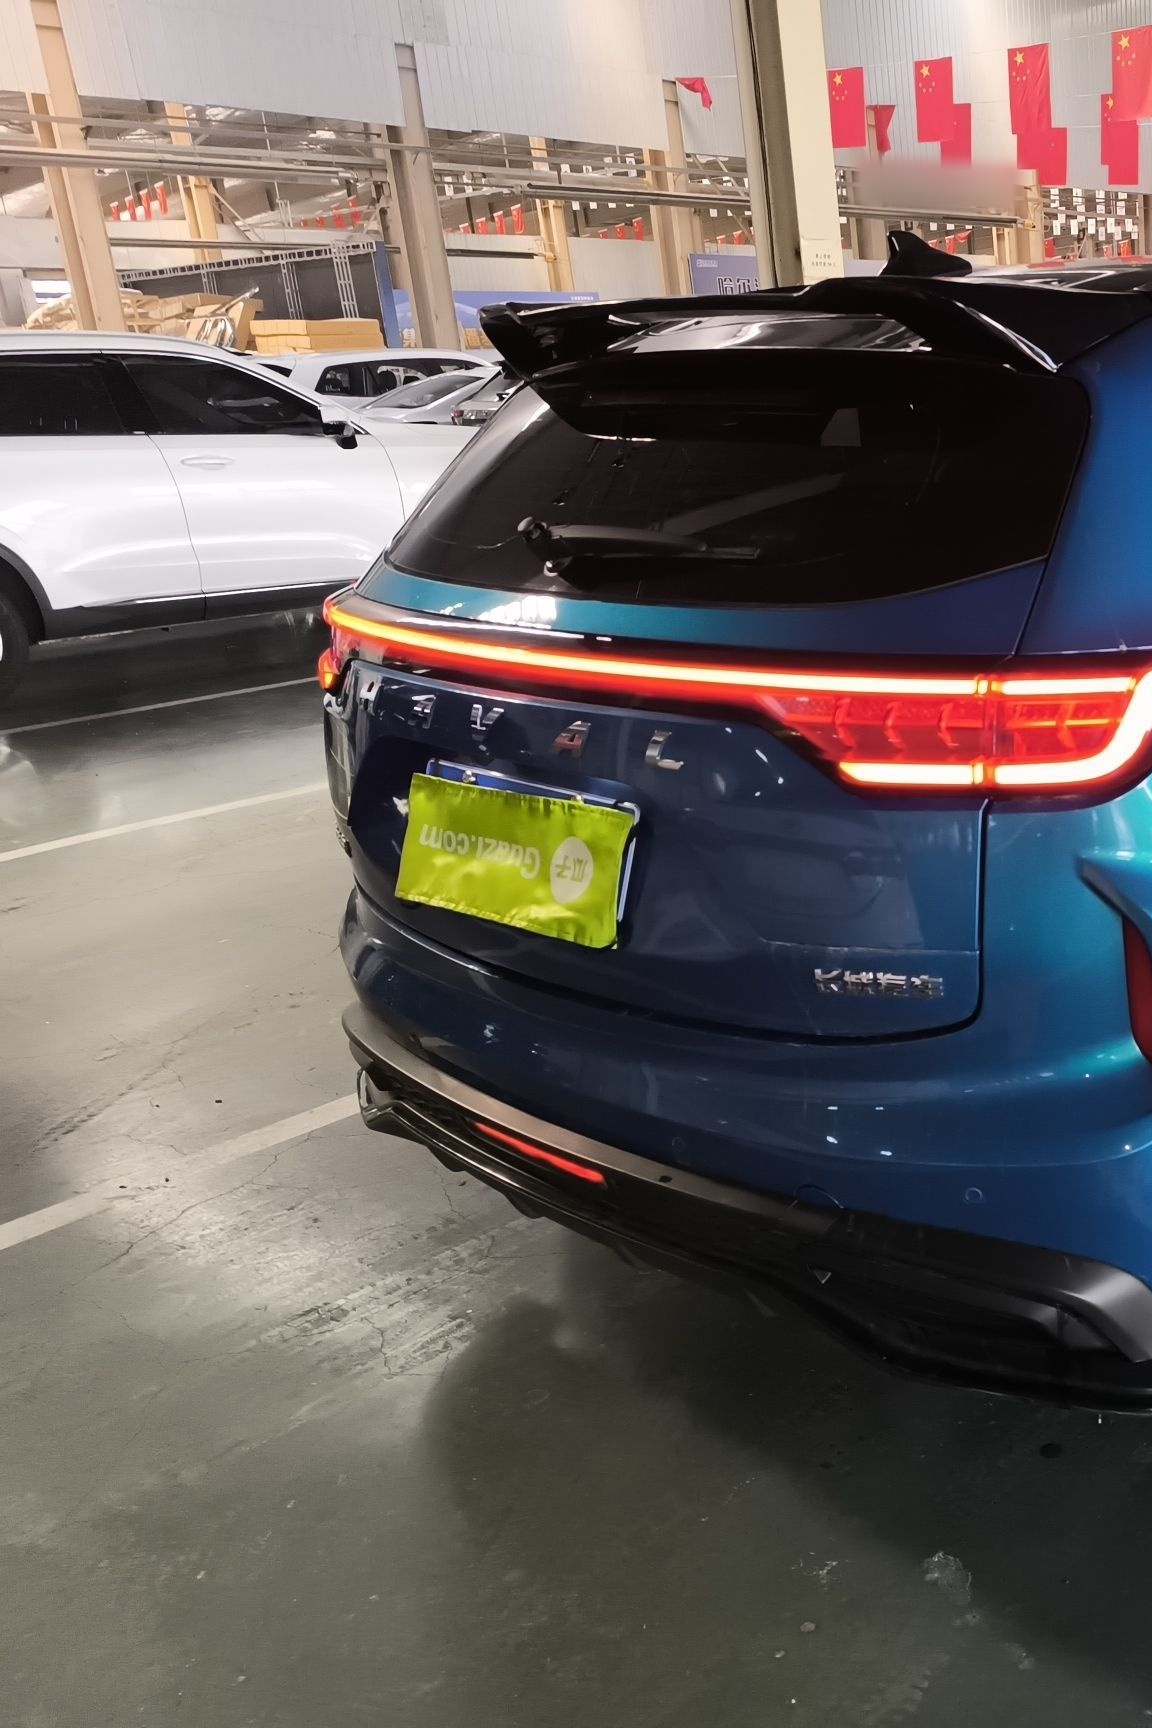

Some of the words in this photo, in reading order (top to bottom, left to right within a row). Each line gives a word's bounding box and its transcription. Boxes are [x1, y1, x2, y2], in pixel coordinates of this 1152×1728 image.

[717, 277, 758, 295] 哈尔
[360, 680, 684, 770] HAVAL
[419, 824, 541, 880] Guazi.com
[555, 855, 588, 882] 瓜子
